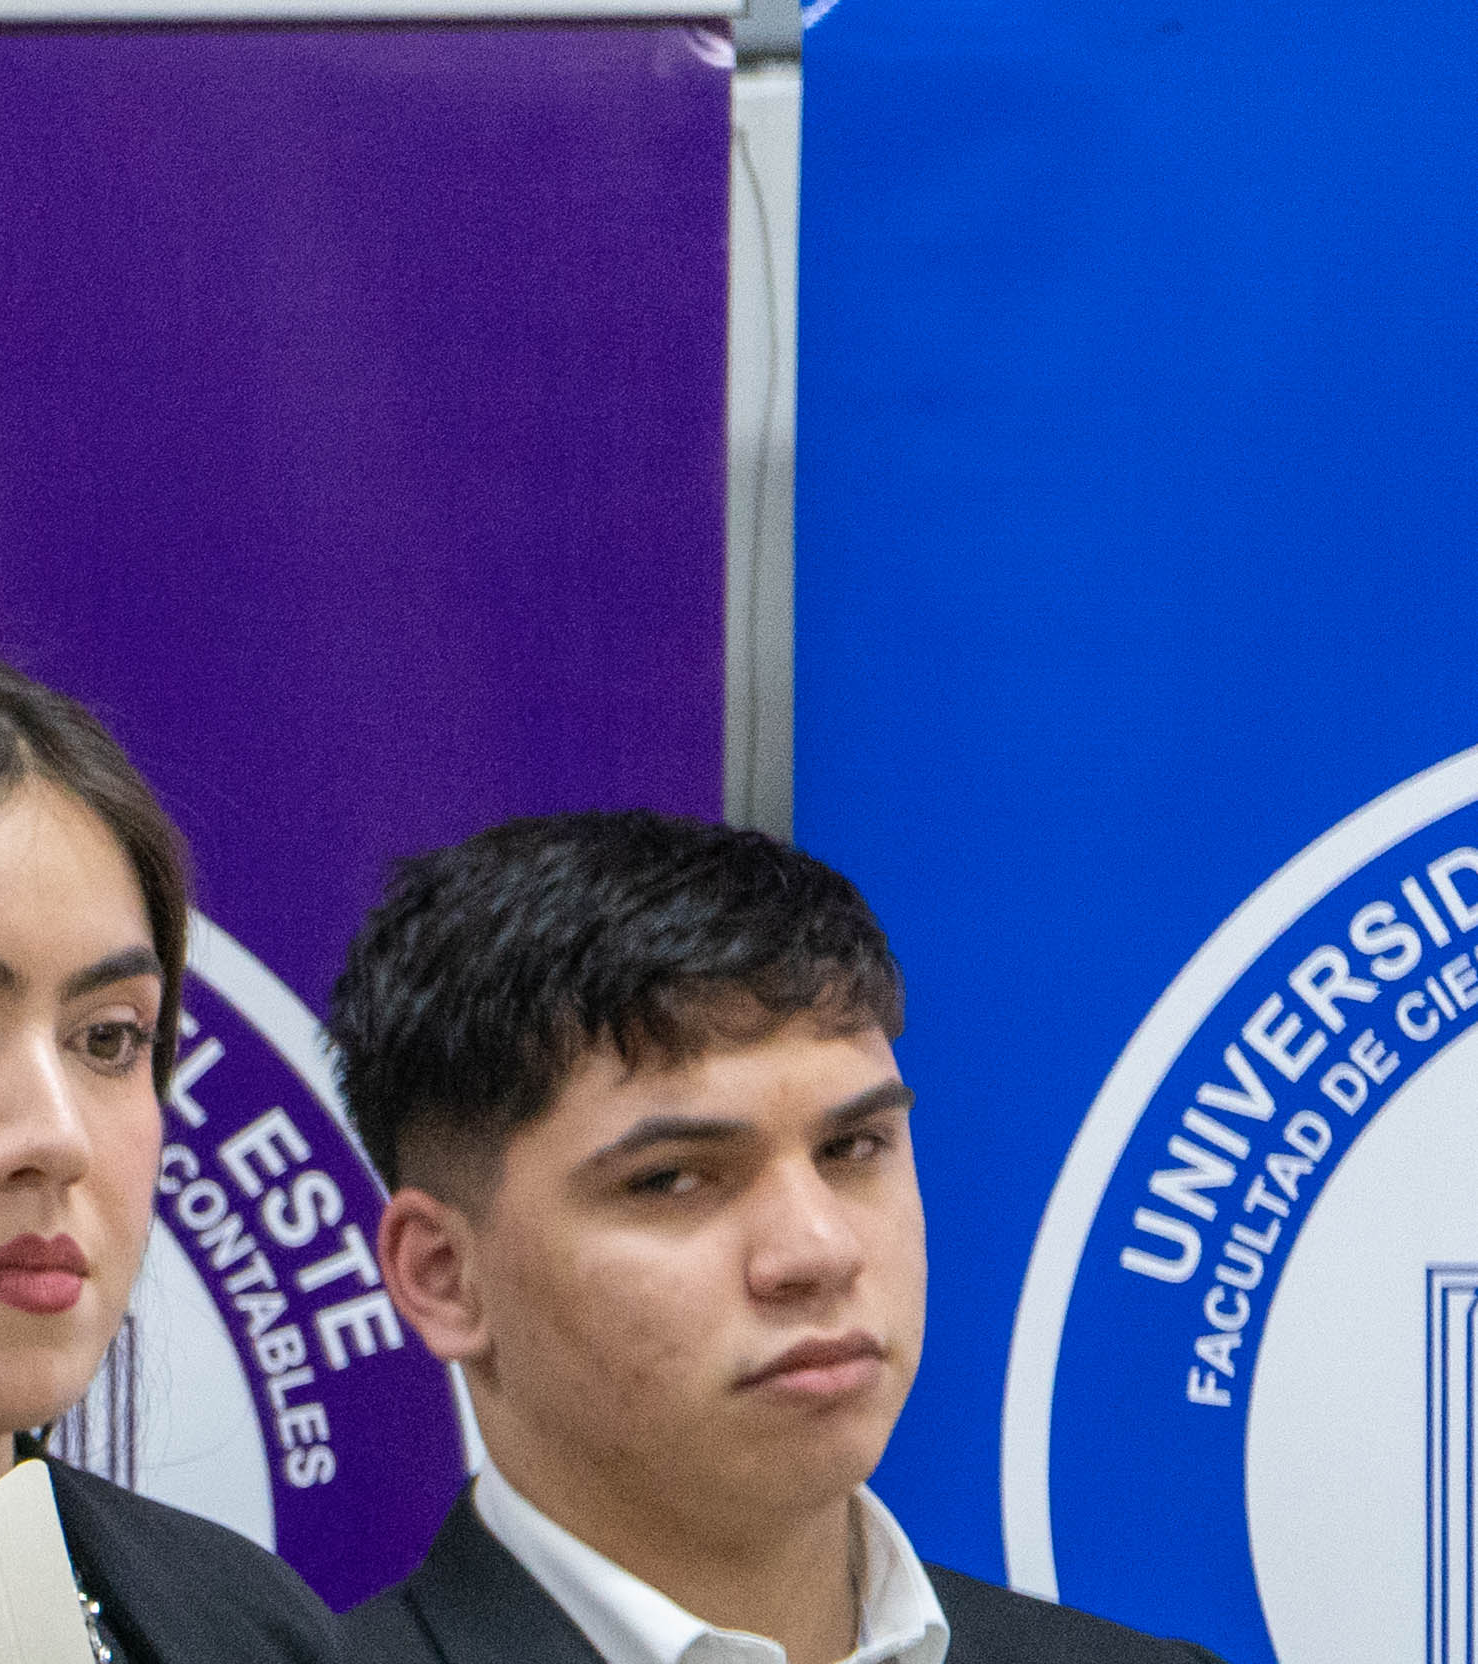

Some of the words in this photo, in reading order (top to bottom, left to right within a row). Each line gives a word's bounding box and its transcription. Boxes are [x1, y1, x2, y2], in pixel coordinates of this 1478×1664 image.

[157, 1141, 339, 1491] CONTABLES
[217, 1105, 406, 1372] ESTE
[1185, 1108, 1333, 1408] FACULTAD
[1318, 1027, 1402, 1117] DE
[1394, 944, 1478, 1042] CIE
